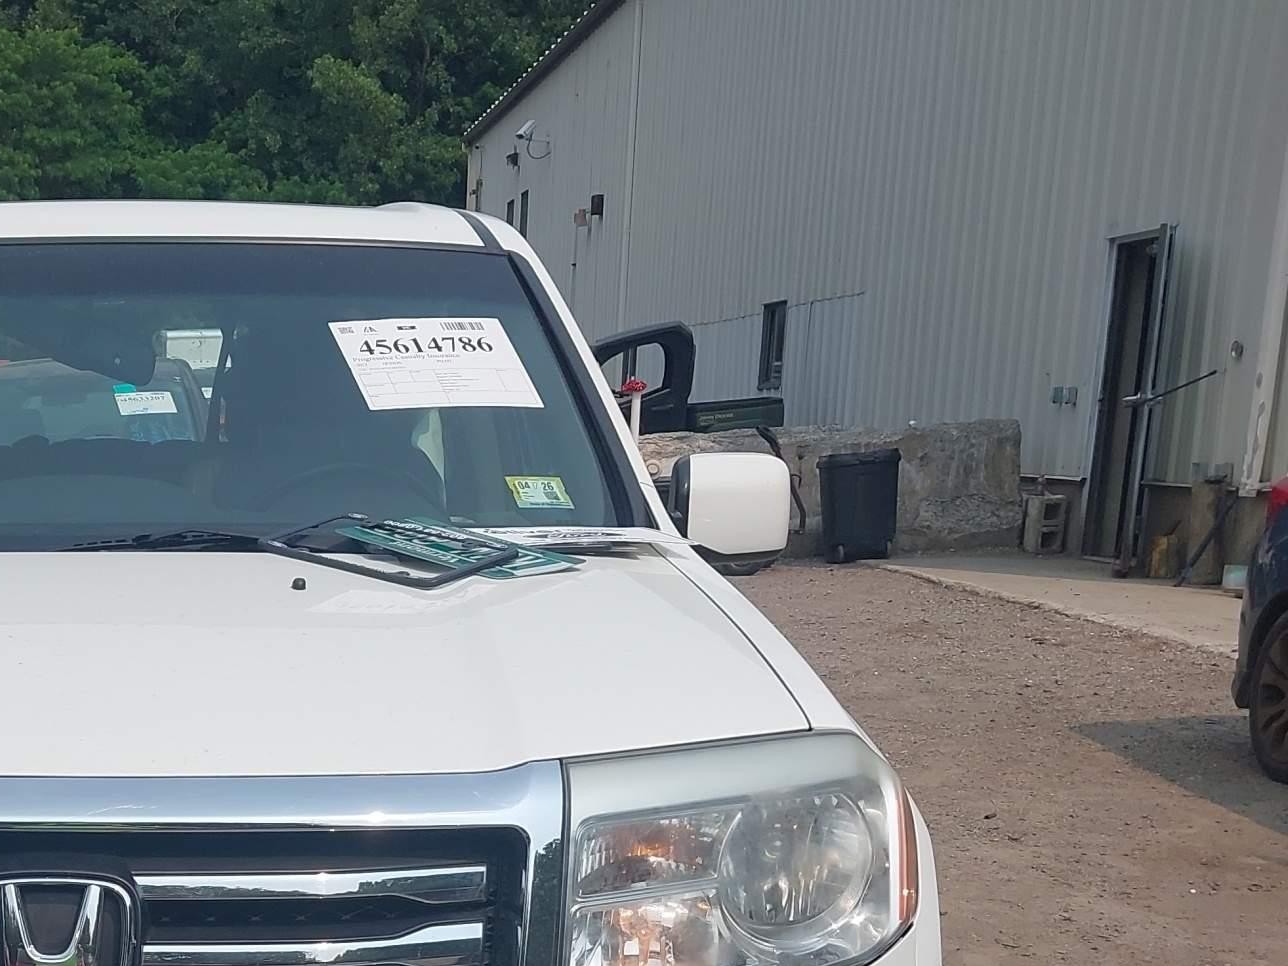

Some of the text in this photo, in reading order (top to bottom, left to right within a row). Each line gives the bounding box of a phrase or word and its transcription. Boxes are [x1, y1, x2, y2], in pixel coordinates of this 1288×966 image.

[359, 335, 494, 355] 45614786
[517, 481, 554, 491] 04 26
[389, 541, 460, 564] Vermont
